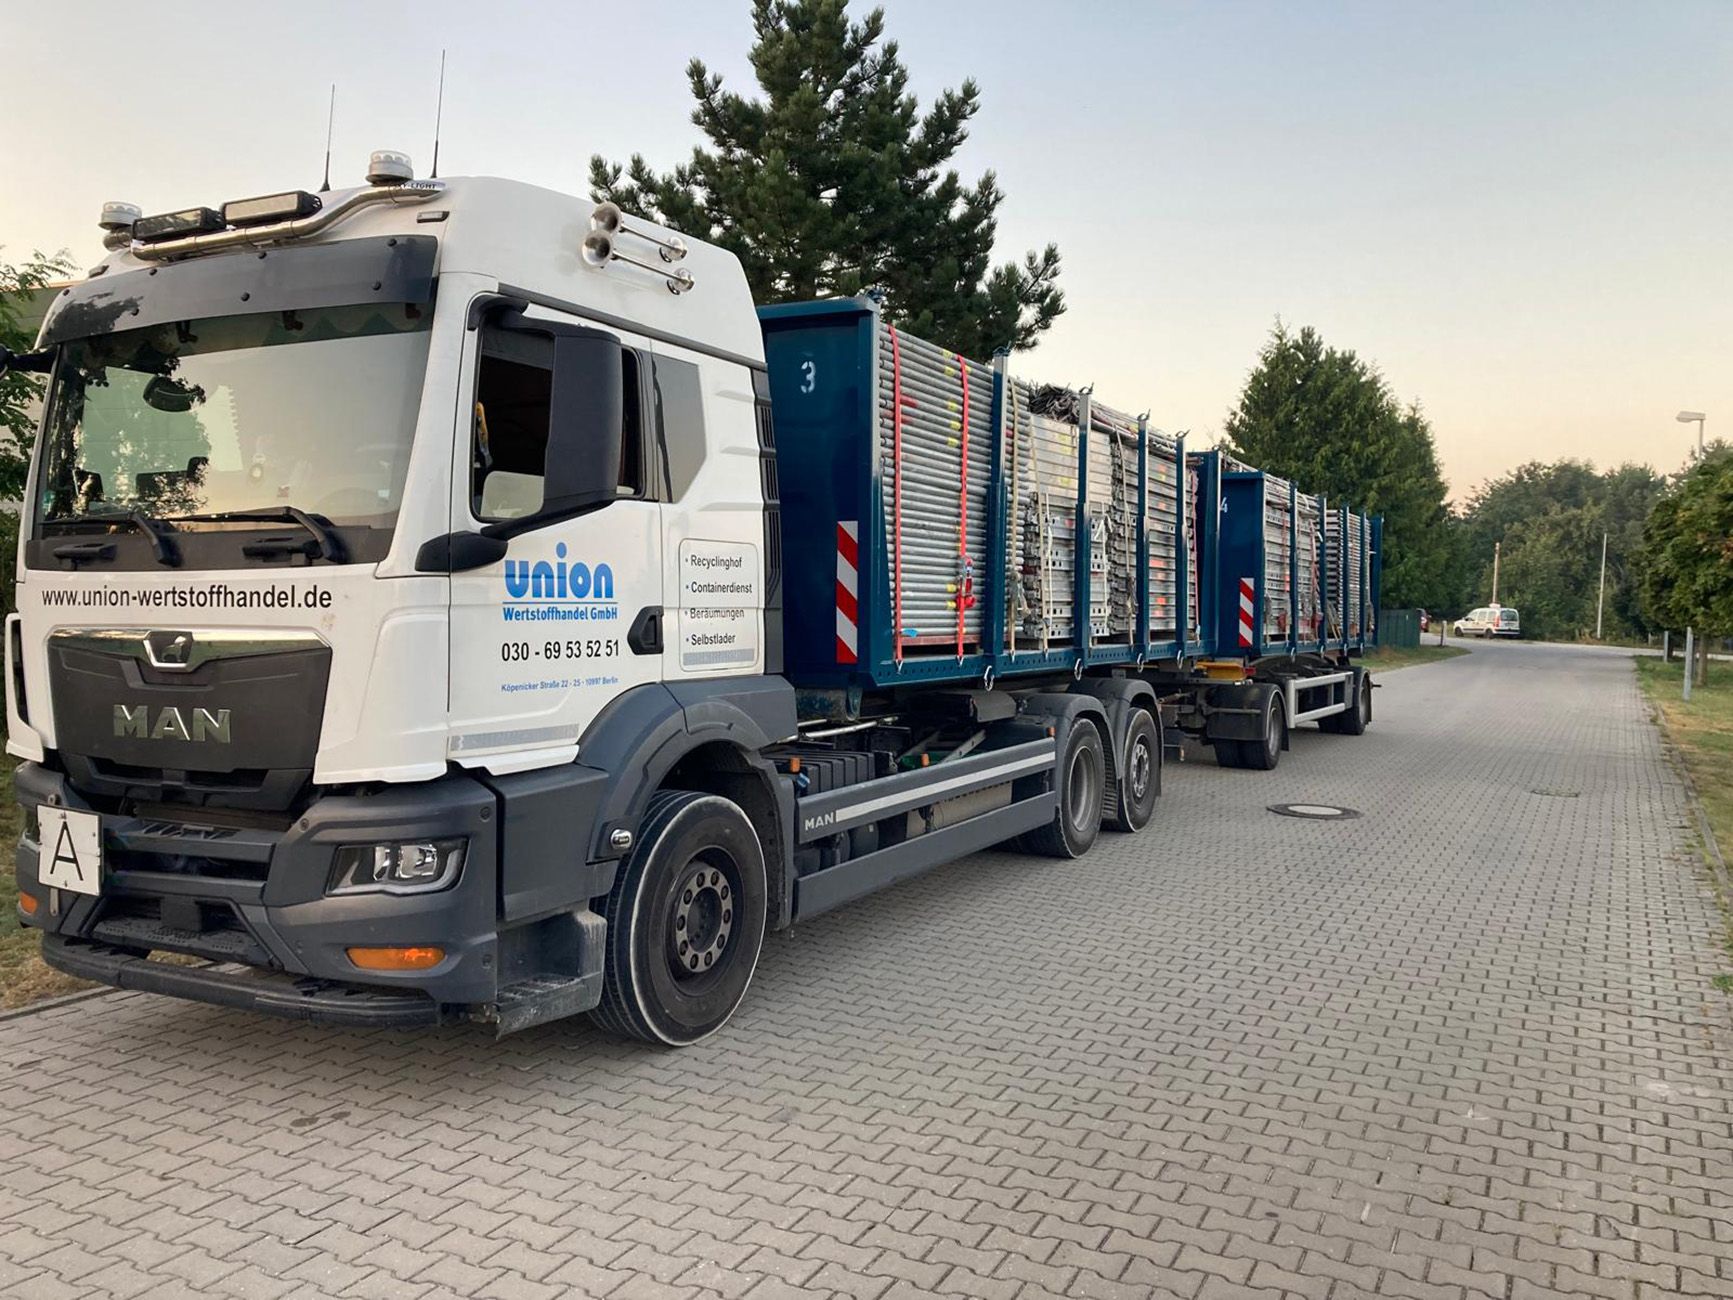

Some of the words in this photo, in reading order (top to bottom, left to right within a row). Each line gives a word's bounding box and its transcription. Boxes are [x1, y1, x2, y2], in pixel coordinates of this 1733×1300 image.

[801, 361, 816, 393] 3
[505, 542, 614, 599] union
[691, 555, 742, 570] Recyclinghof
[42, 584, 333, 608] www.union-wertstoffhandel.de
[691, 582, 753, 593] Containerdienst
[503, 607, 588, 621] Wertstoffhandel
[590, 607, 618, 620] GmbH
[690, 608, 744, 621] Beräumungen
[691, 633, 736, 646] Selbstlader
[502, 642, 529, 661] 030
[544, 641, 561, 660] 69
[566, 640, 582, 659] 53
[586, 639, 602, 658] 52
[605, 639, 619, 657] 51
[501, 683, 539, 693] Köpenicker
[561, 680, 569, 688] 22
[113, 704, 232, 744] MAN
[804, 811, 834, 831] MAN
[50, 821, 84, 881] A
